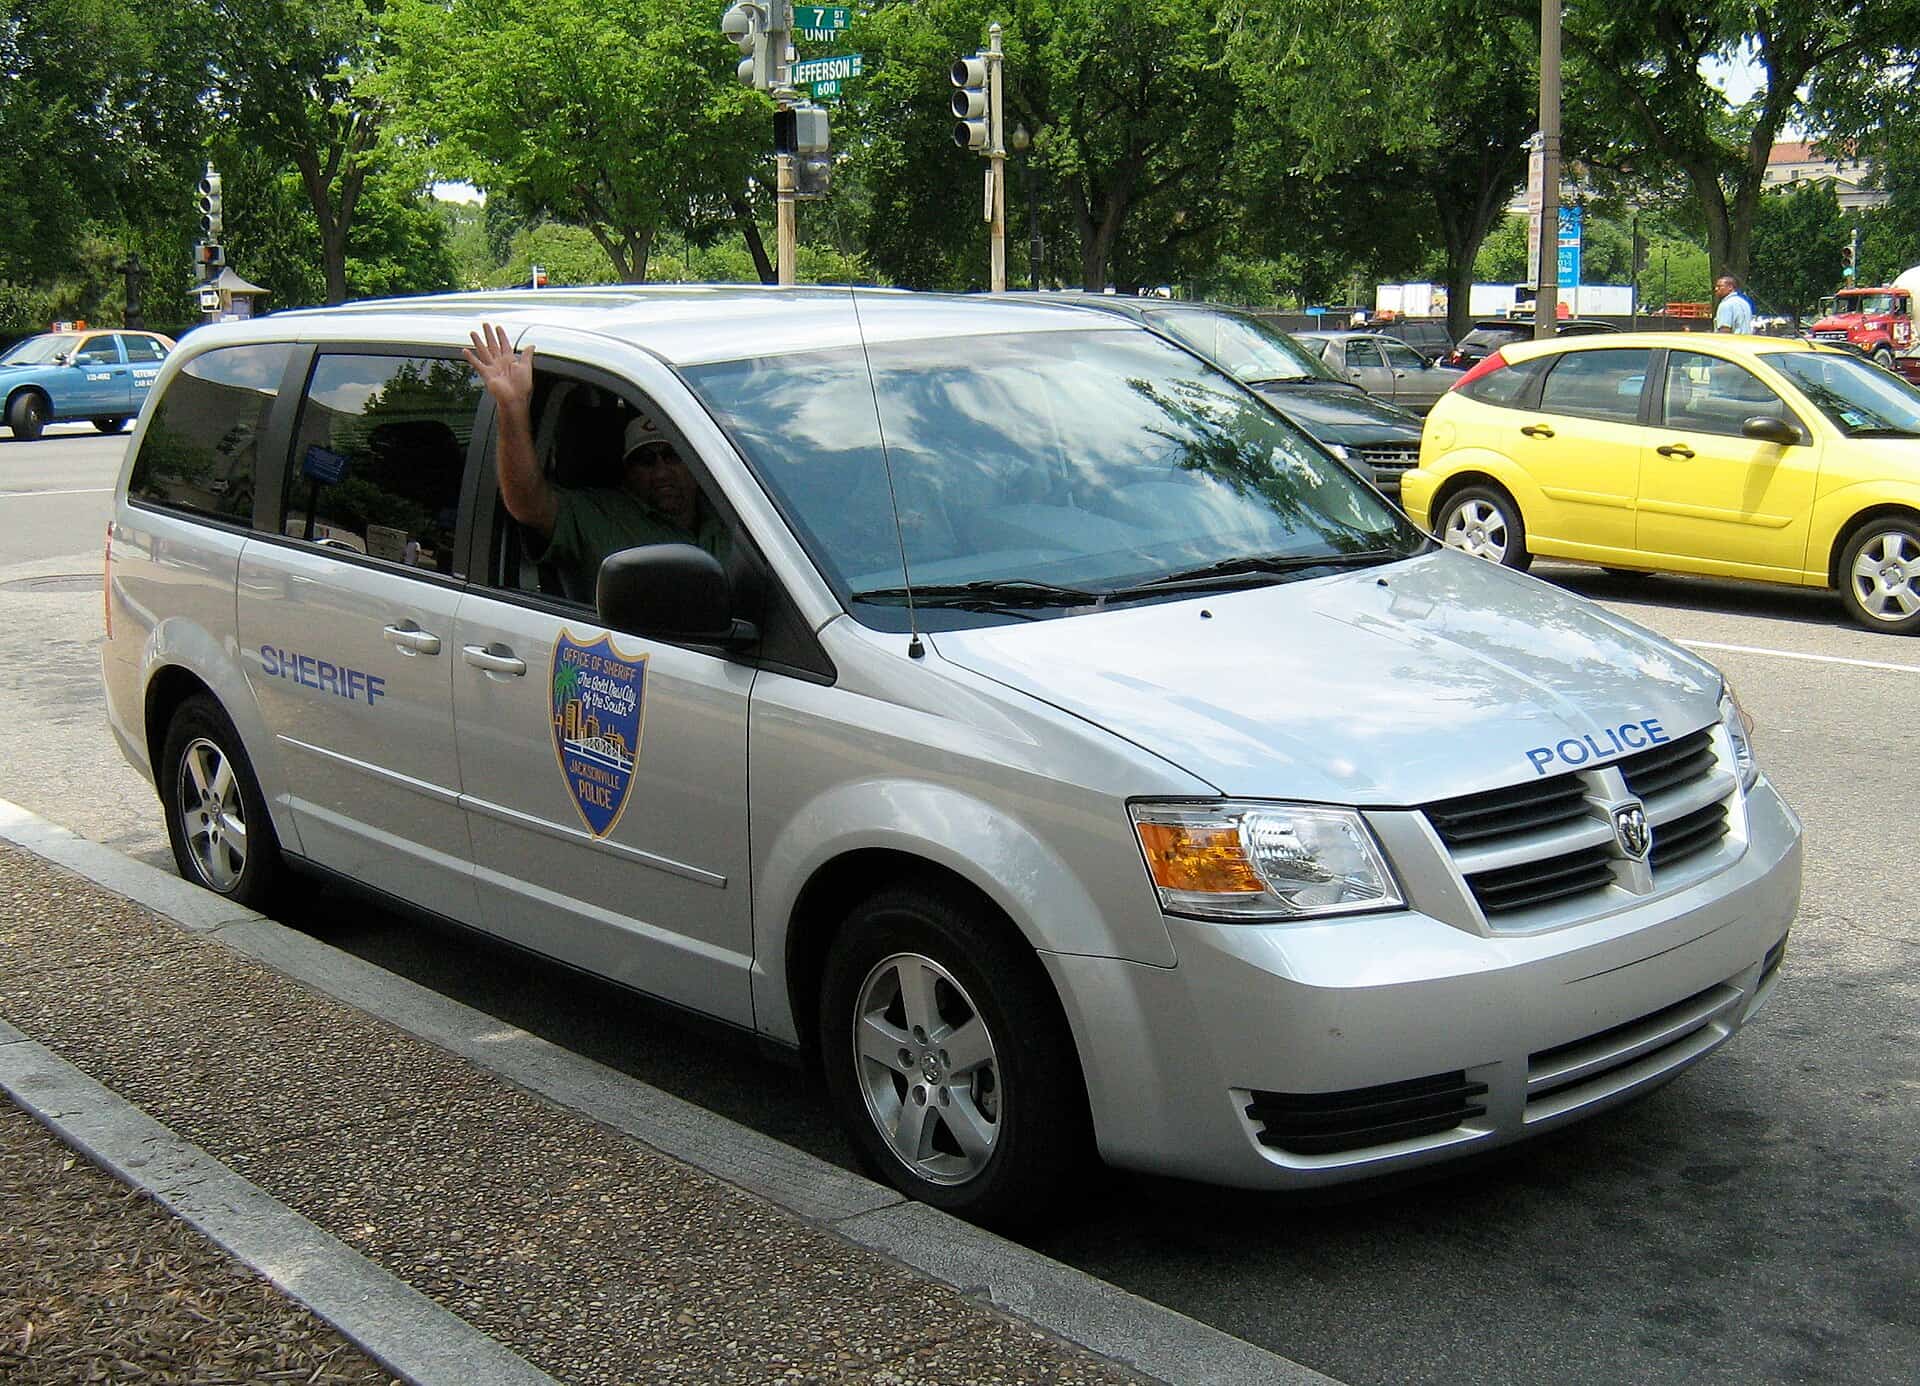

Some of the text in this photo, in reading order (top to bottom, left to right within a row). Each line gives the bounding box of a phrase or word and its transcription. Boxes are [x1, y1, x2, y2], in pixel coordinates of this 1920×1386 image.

[813, 8, 825, 27] 7
[805, 28, 836, 42] UNIT
[793, 58, 850, 84] JEFFERSON
[817, 81, 836, 96] 600
[260, 644, 385, 706] SHERIFF
[563, 647, 637, 683] OFFICE OF SHERIFF
[578, 671, 592, 688] The
[591, 675, 610, 695] Bold
[622, 685, 637, 712] City
[582, 690, 627, 717] of the South
[1525, 718, 1671, 775] POLICE
[569, 759, 621, 790] JACKSONVILLE
[578, 779, 612, 810] POLICE
